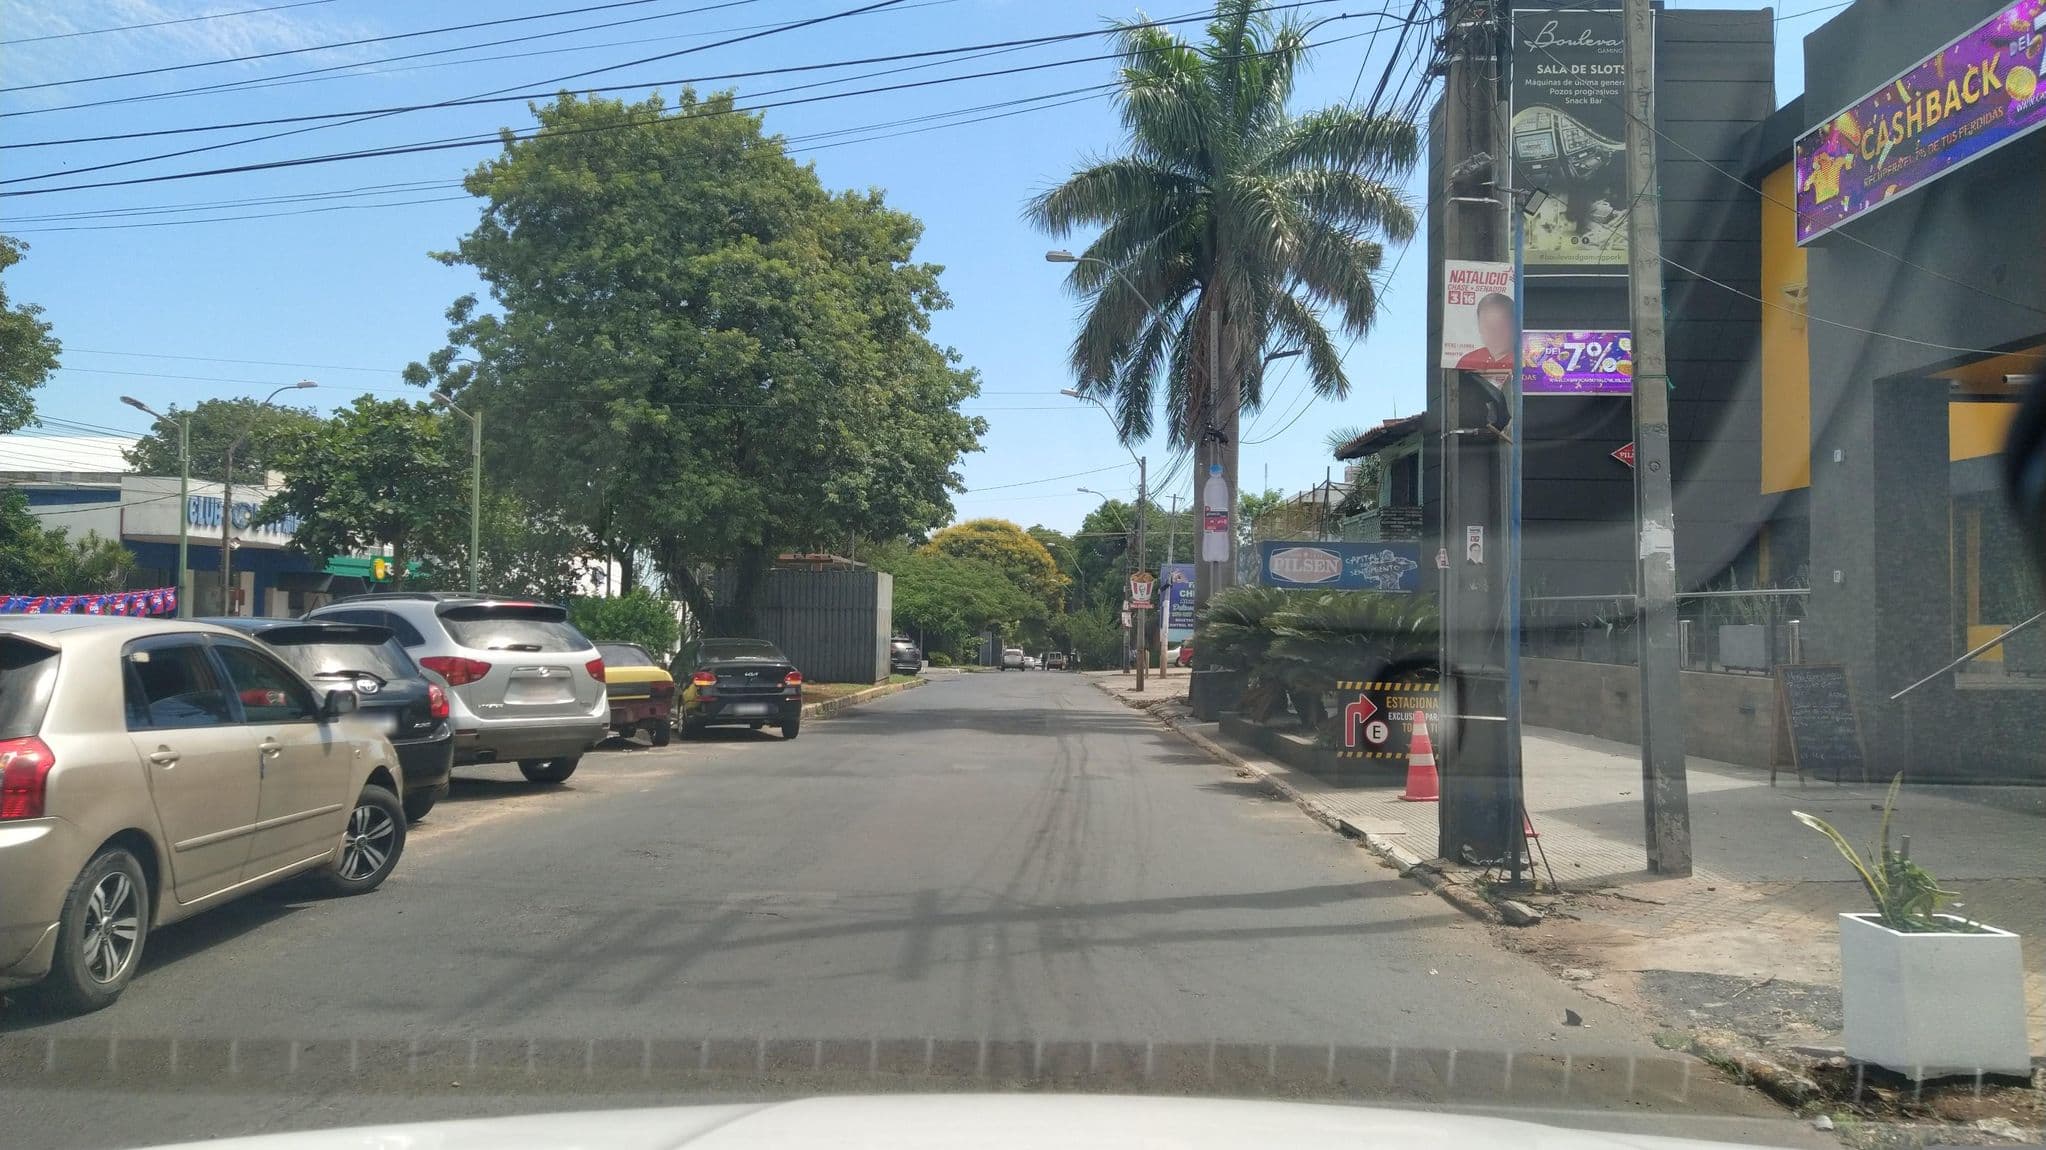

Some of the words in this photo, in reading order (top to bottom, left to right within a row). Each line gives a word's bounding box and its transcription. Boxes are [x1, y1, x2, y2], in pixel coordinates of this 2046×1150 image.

[2009, 33, 2032, 57] DEL
[1537, 65, 1567, 74] SALA
[1571, 65, 1587, 74] DE
[1860, 51, 2003, 161] CASHBACK
[1942, 130, 1958, 147] TUS
[1449, 270, 1508, 285] NATALICIO
[1451, 293, 1459, 303] 3
[1463, 294, 1475, 304] 16
[1563, 342, 1617, 373] 7%
[188, 496, 223, 526] CLUB
[1273, 558, 1339, 573] PILSEN
[1388, 712, 1415, 721] EXCLUSI
[1373, 725, 1381, 739] E
